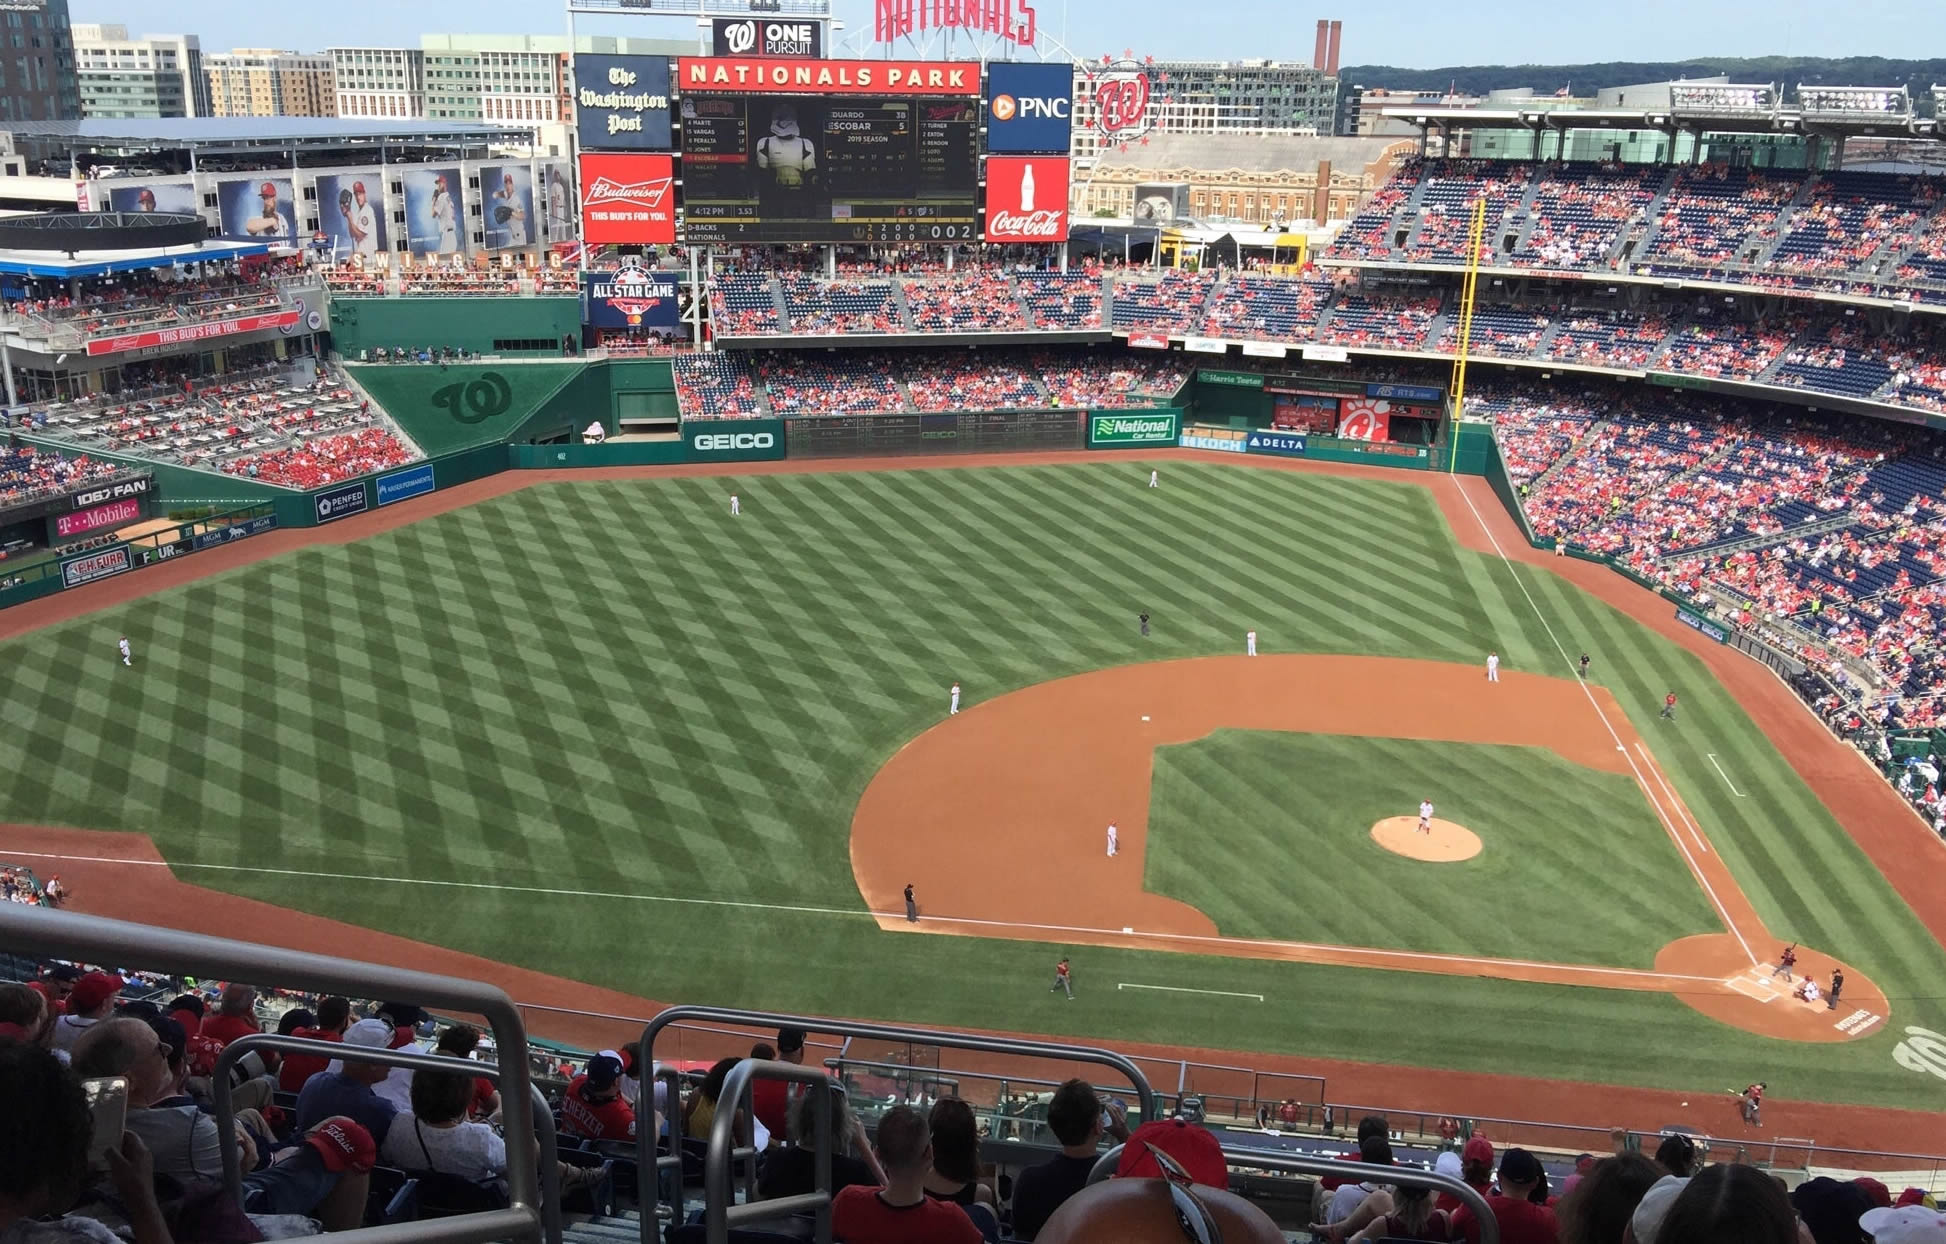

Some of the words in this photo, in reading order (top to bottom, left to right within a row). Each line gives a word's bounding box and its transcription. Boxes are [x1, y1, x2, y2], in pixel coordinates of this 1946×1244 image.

[766, 24, 812, 42] ONE
[766, 41, 812, 54] PURSUIT
[608, 67, 636, 88] The
[690, 64, 872, 86] NATIONALS
[888, 67, 965, 88] PARK
[580, 86, 668, 112] Washington
[1019, 97, 1069, 119] PNC
[608, 114, 643, 136] Post
[590, 183, 663, 199] Budweiser
[590, 211, 608, 221] THIS
[609, 211, 632, 221] BUD'S
[634, 212, 649, 221] FOR
[990, 210, 1063, 237] Coca-Cola
[593, 285, 614, 298] ALL
[615, 285, 643, 298] STAR
[645, 285, 674, 298] GAME
[158, 330, 179, 343] THIS
[179, 326, 204, 340] BUD'S
[205, 324, 221, 336] FOR
[1113, 418, 1170, 434] National
[694, 432, 774, 450] GEICO
[1148, 431, 1167, 439] Rental
[1199, 436, 1241, 450] KOCH
[1263, 438, 1303, 450] DELTA
[114, 480, 146, 497] FAN
[332, 491, 363, 507] PENFED
[252, 518, 271, 529] MGM
[202, 532, 221, 543] MGM
